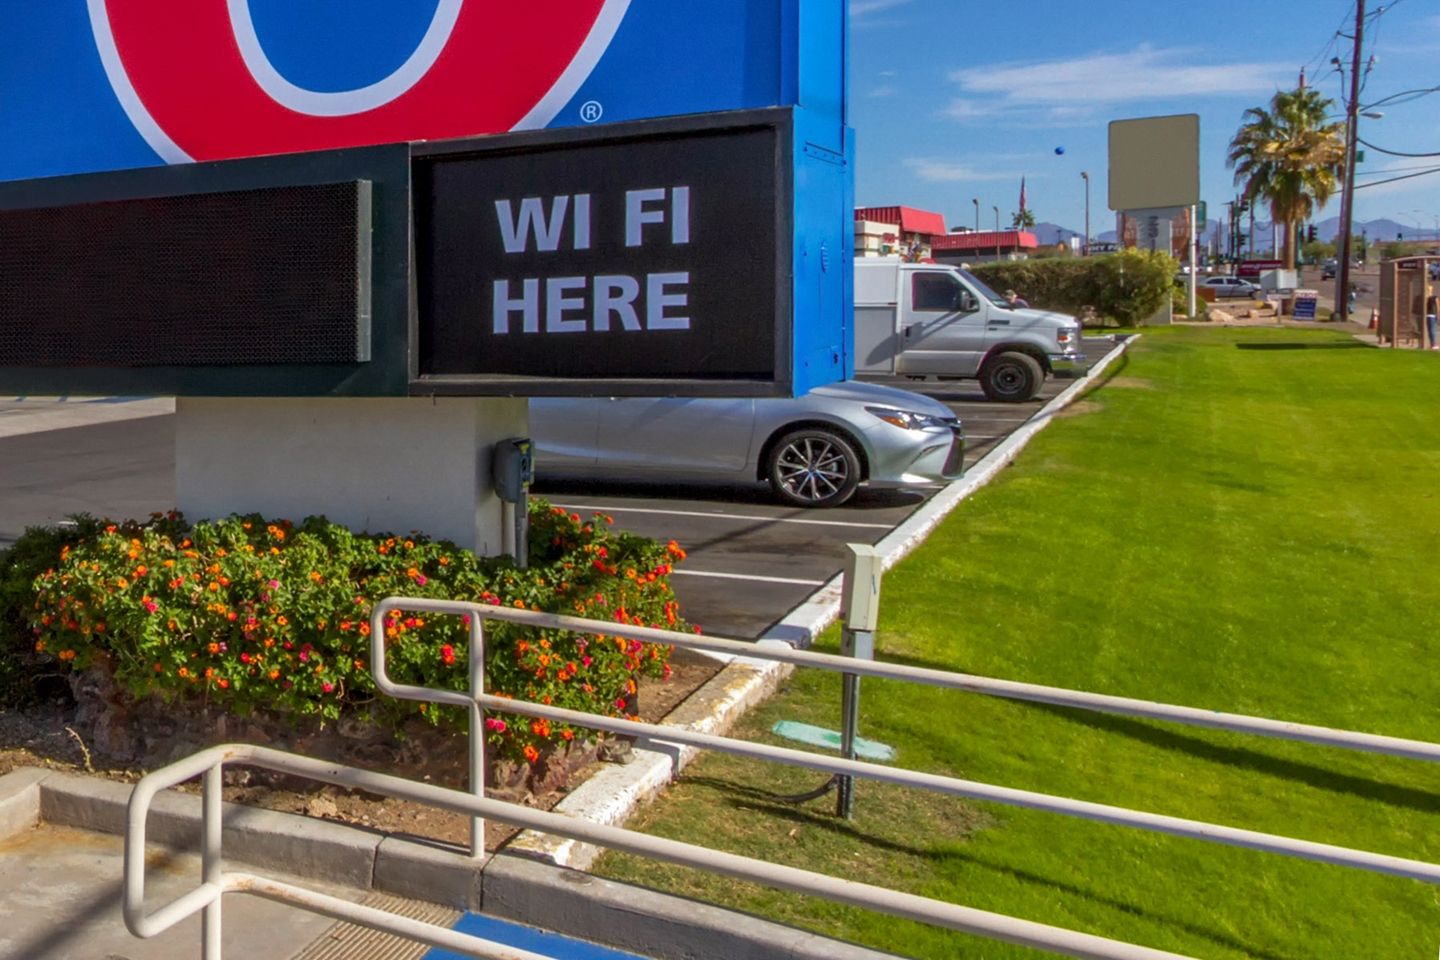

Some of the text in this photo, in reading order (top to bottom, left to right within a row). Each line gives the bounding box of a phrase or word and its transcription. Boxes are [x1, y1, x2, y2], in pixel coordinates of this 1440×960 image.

[495, 186, 689, 253] WI FI
[494, 272, 690, 334] HERE
